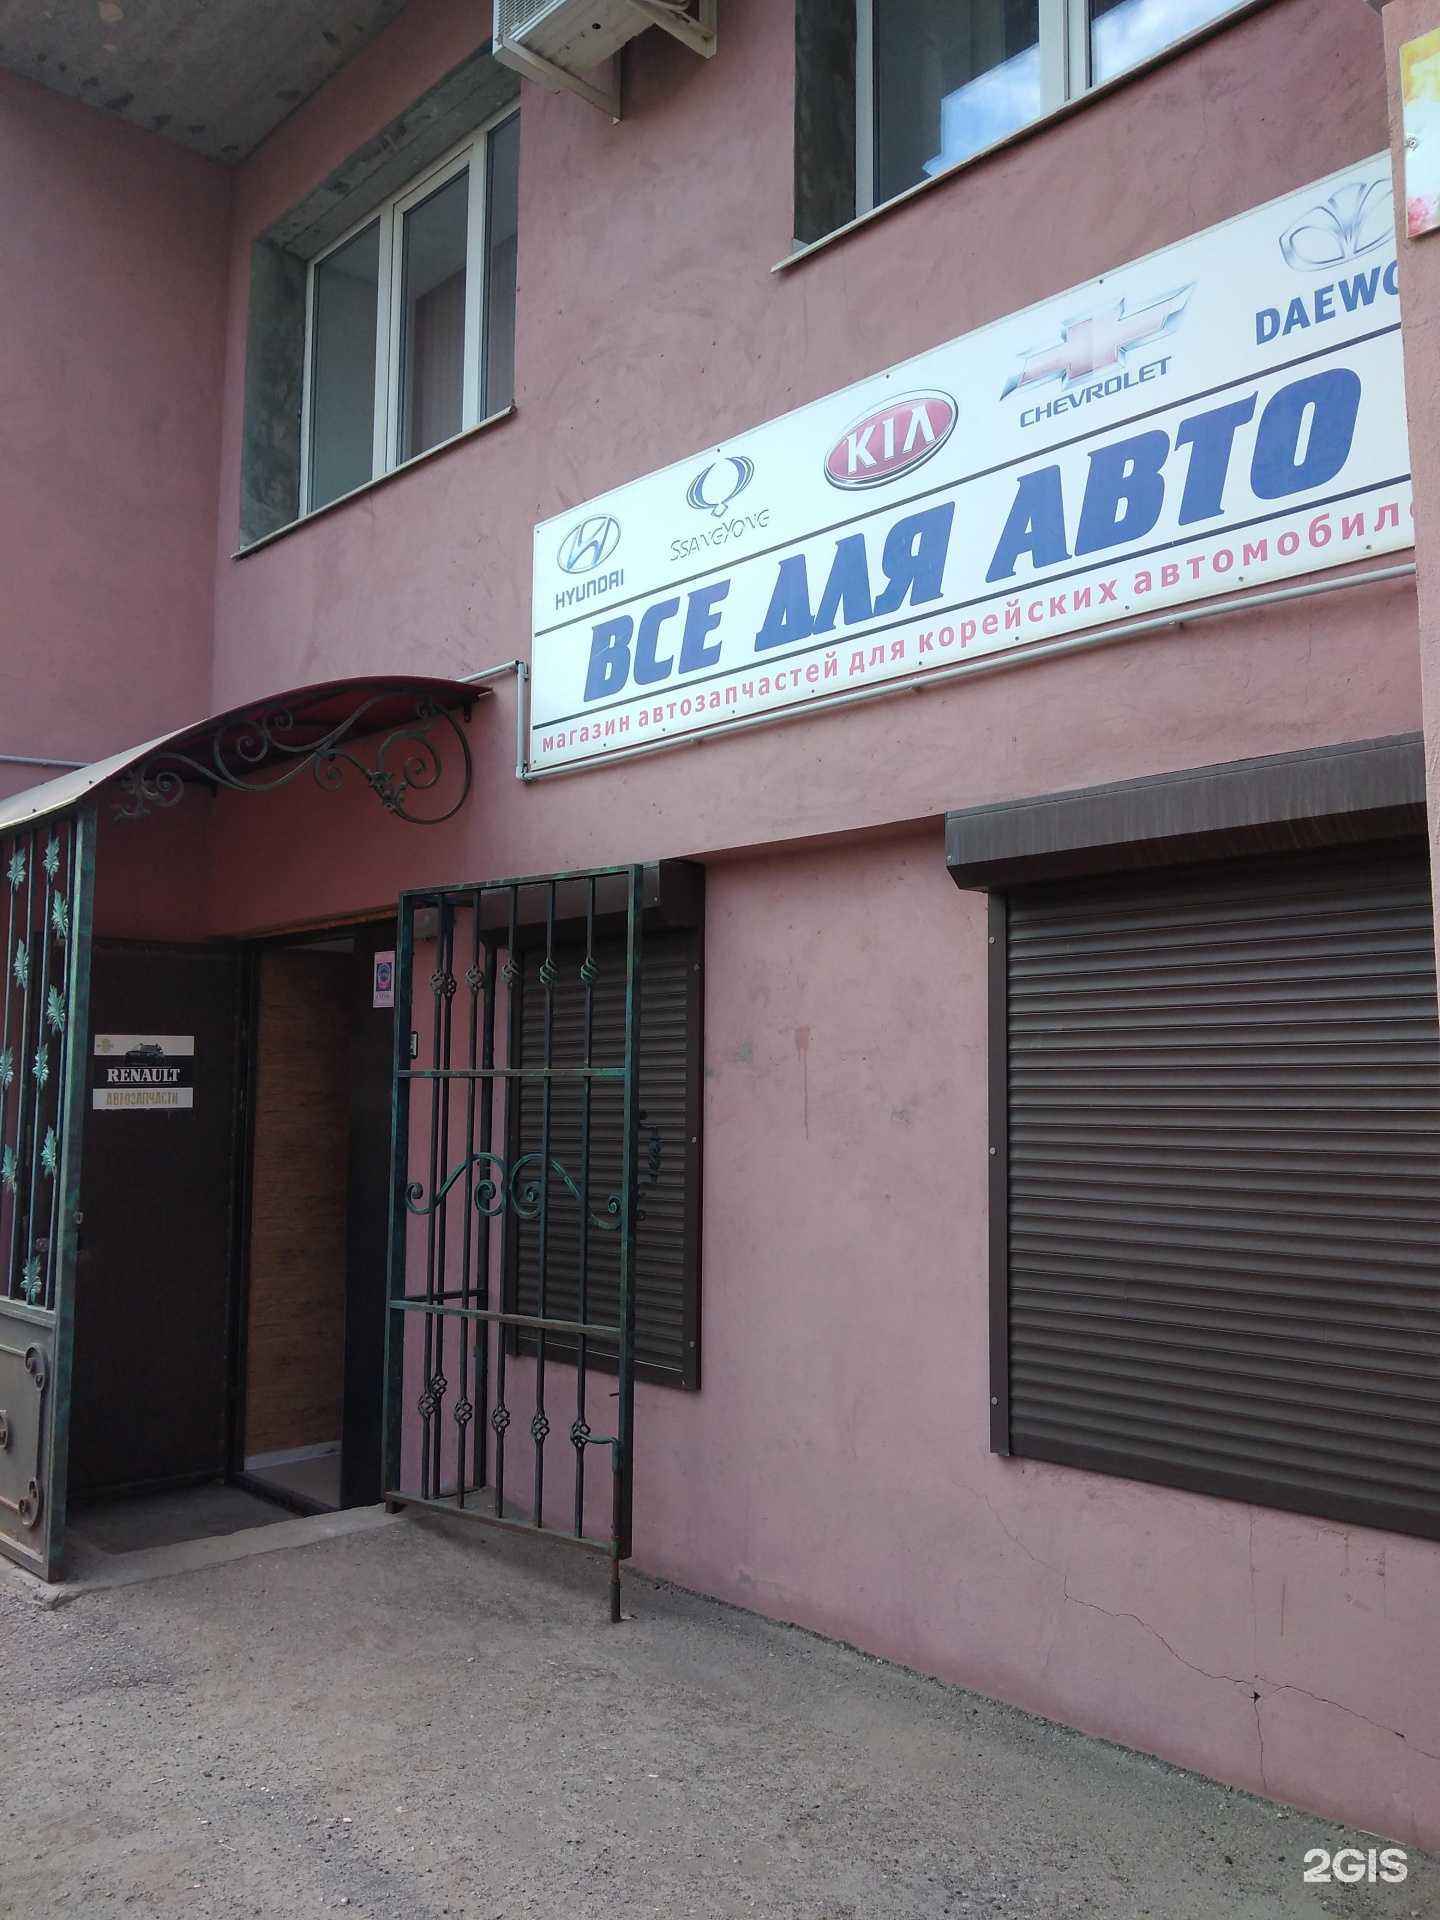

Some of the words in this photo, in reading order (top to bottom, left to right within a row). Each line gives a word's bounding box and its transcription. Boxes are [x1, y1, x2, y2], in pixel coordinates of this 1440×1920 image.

[1019, 355, 1171, 428] CHEVROLET
[847, 402, 936, 475] KIA
[583, 578, 732, 702] ВСЕ
[754, 500, 956, 652] ДЛЯ
[985, 367, 1362, 583] АВТО
[541, 713, 631, 753] магазин
[637, 650, 839, 727] автозапчастей
[848, 637, 905, 677] для
[918, 575, 1117, 655] корейских
[1133, 493, 1416, 595] автомобил
[555, 568, 624, 611] HYUNDAI
[106, 1068, 180, 1082] RENAULT
[106, 1091, 178, 1105] АВТОЗАПЧАСТИ
